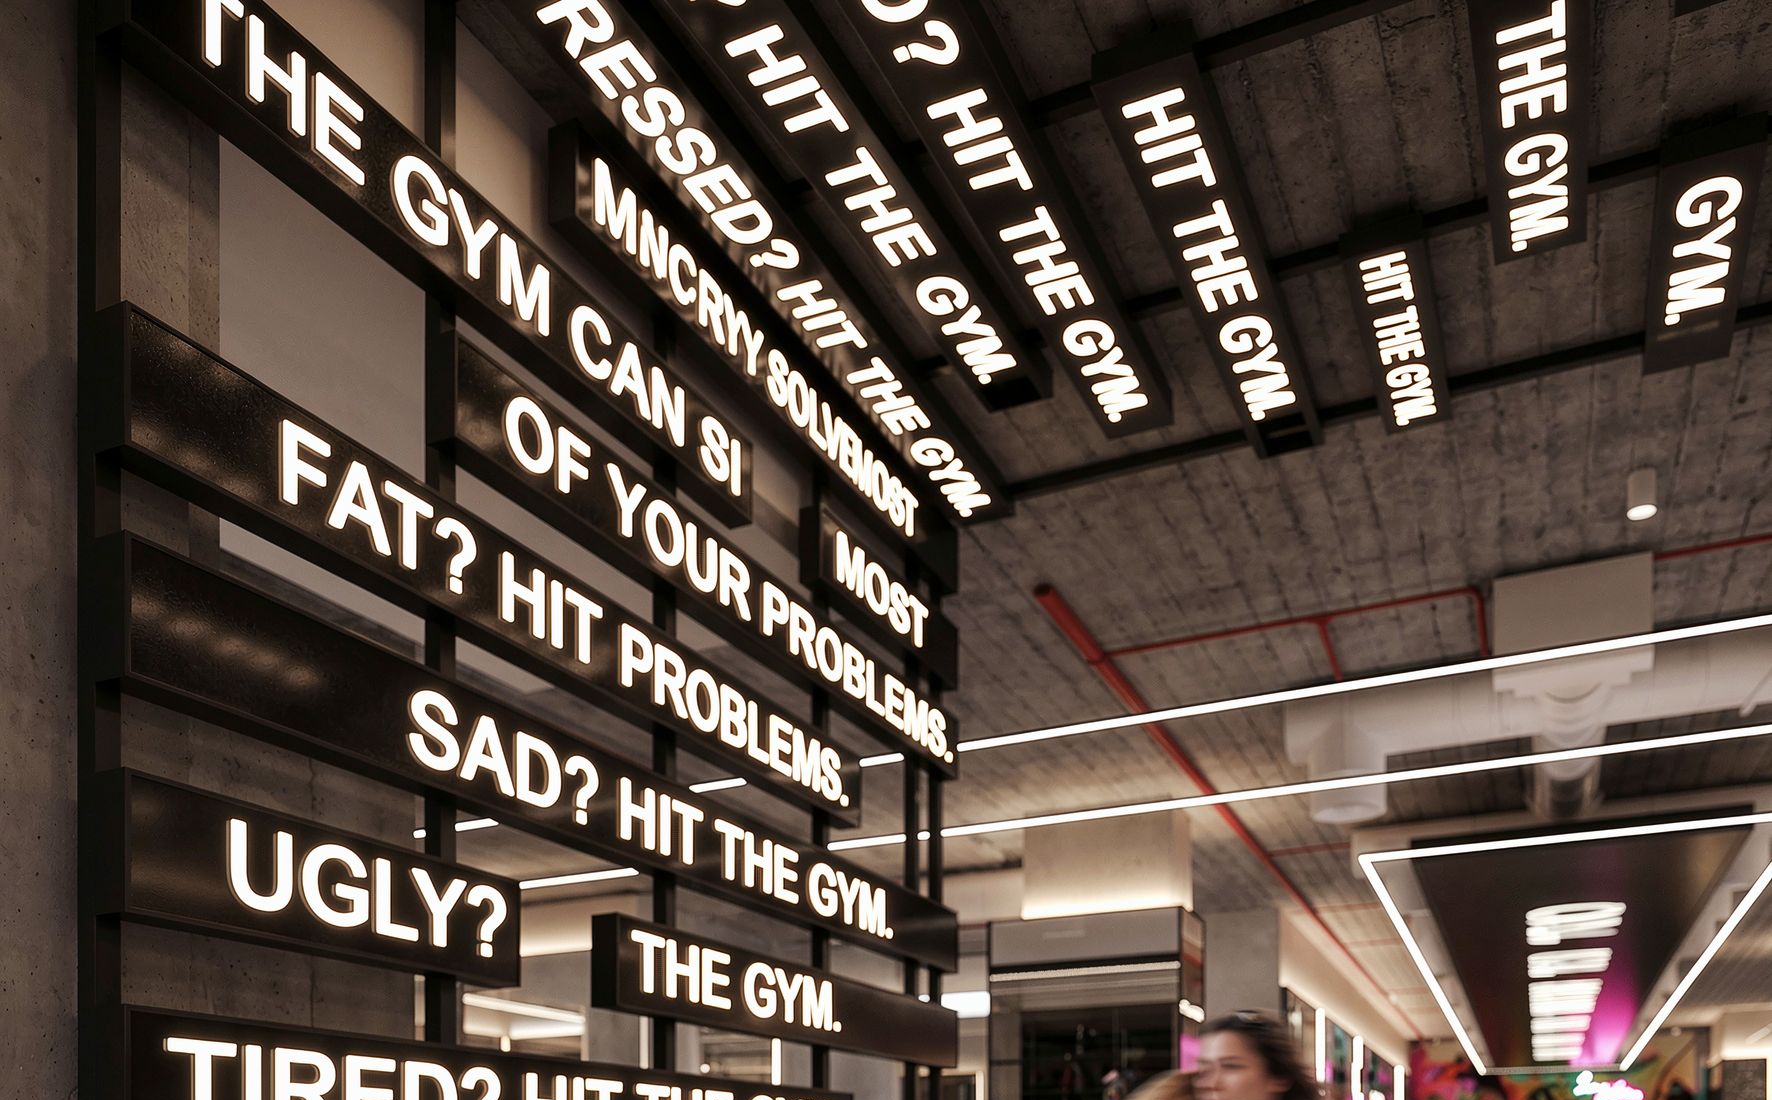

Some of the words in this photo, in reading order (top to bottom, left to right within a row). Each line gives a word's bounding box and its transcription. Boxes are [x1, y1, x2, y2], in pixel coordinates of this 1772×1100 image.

[1494, 0, 1568, 130] THE
[204, 0, 366, 187] THE
[392, 154, 551, 338] GYM
[570, 304, 686, 448] CAN
[699, 415, 742, 497] SI
[723, 23, 851, 134] HIT
[824, 145, 938, 268] THE
[915, 275, 1018, 386] GYM.
[925, 87, 1034, 192] HIT
[998, 204, 1096, 317] THE
[1061, 318, 1149, 424] GYM.
[1120, 86, 1218, 189] HIT
[1172, 198, 1259, 314] THE
[1218, 314, 1297, 422] GYM.
[1358, 250, 1416, 305] HIT
[1503, 132, 1570, 253] GYM.
[1663, 175, 1744, 327] GYM.
[776, 278, 869, 350] HIT
[845, 355, 932, 437] THE
[909, 436, 992, 519] GYM.
[1372, 304, 1427, 367] THE
[281, 418, 478, 596] FAT?
[501, 550, 604, 665] HIT
[620, 622, 850, 808] PROBLEMS.
[504, 395, 592, 495] OF
[606, 462, 753, 623] YOUR
[762, 580, 955, 764] PROBLEMS.
[835, 530, 930, 649] MOST
[229, 817, 508, 959] UGLY?
[408, 689, 600, 827] SAD?
[619, 775, 705, 866] HIT
[713, 817, 800, 905] THE
[807, 861, 895, 940] GYM.
[629, 928, 733, 1011] THE
[742, 961, 843, 1034] GYM.
